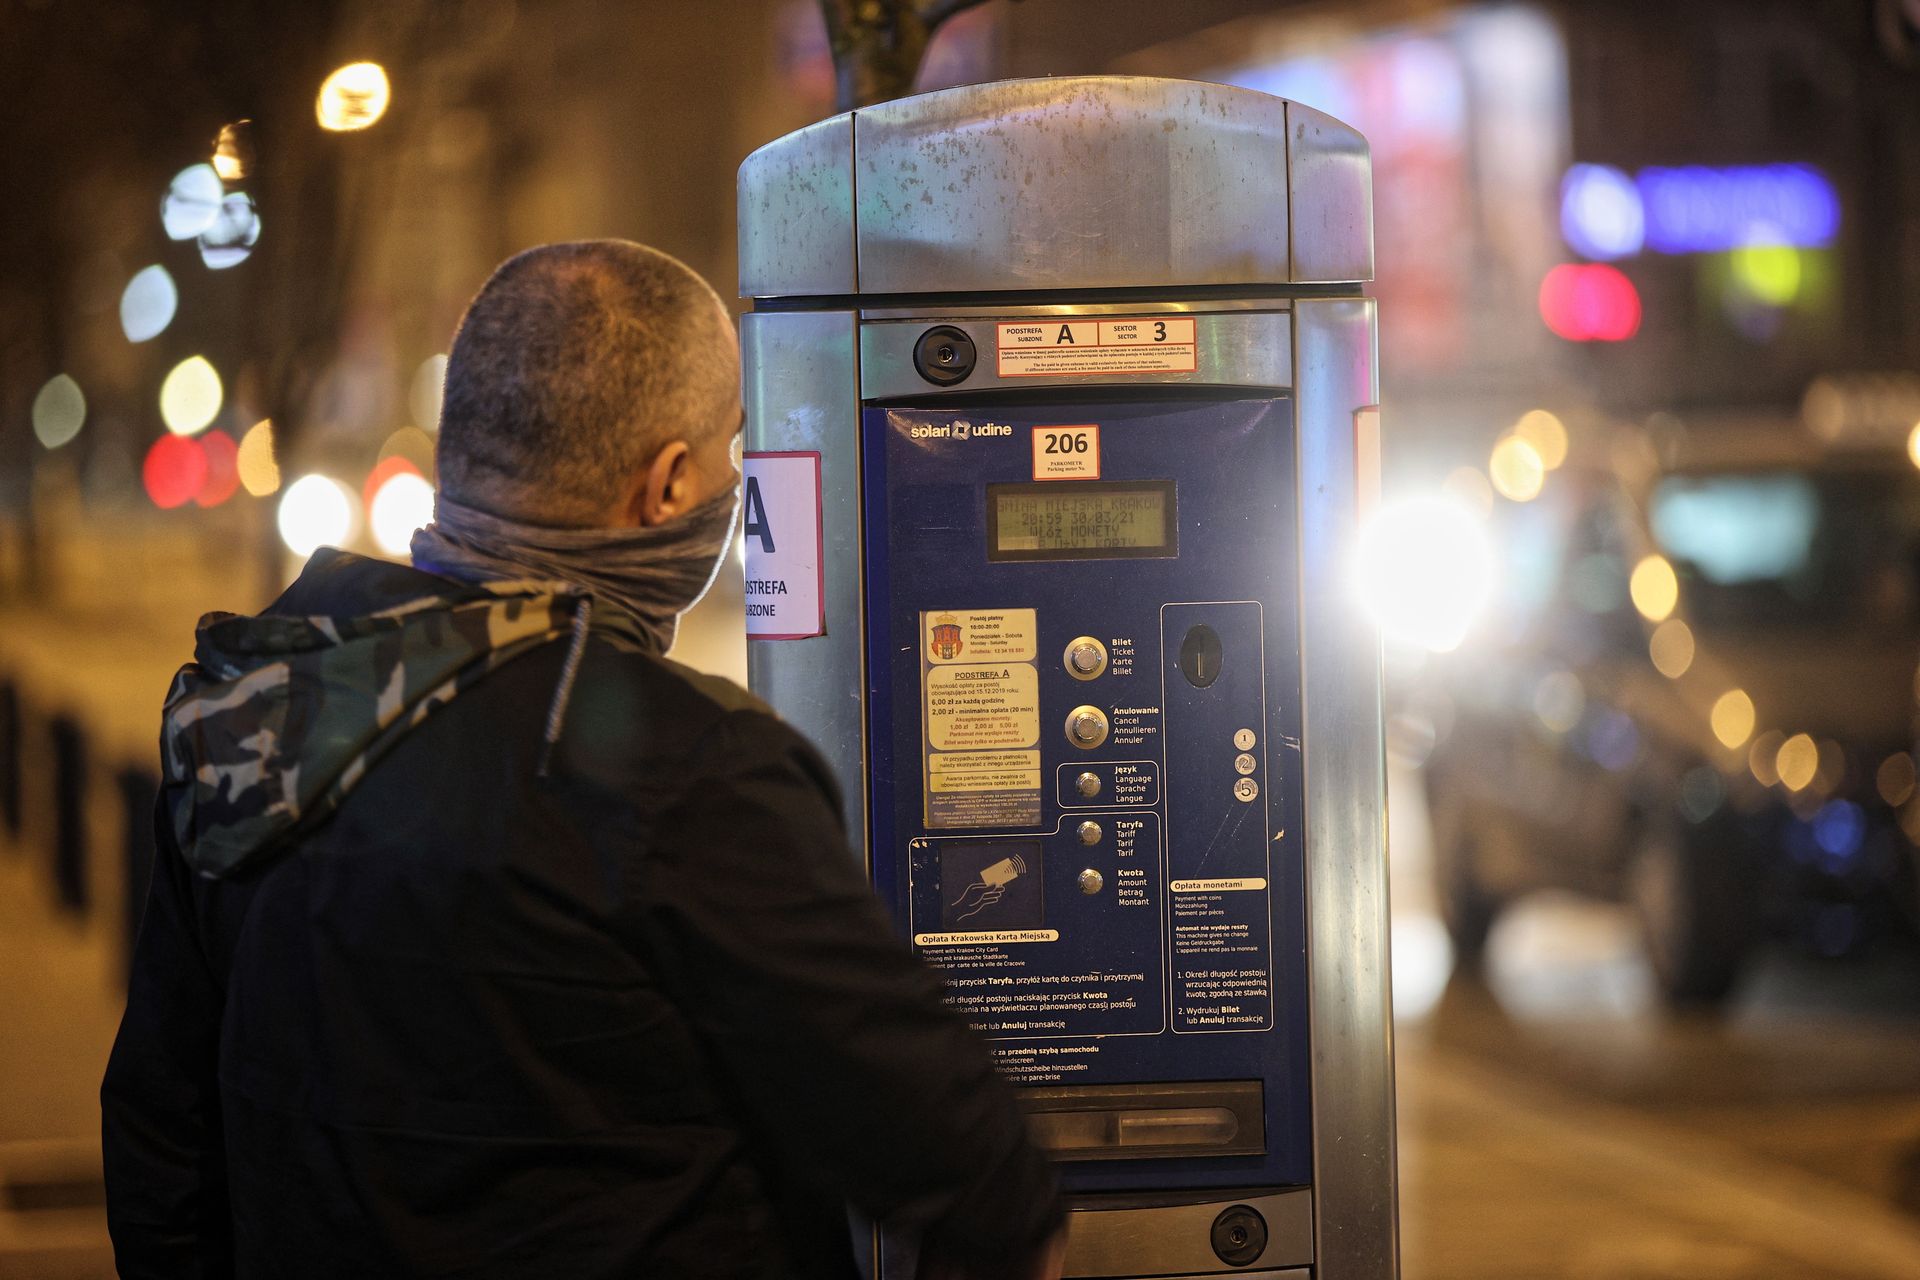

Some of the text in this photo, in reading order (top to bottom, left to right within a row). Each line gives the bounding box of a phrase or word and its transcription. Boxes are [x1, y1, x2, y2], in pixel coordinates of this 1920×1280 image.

[1057, 325, 1074, 344] A
[1154, 322, 1167, 342] 3
[911, 423, 1012, 438] solari udine
[1045, 433, 1088, 454] 206
[1045, 499, 1103, 512] MIEJSKA
[744, 476, 776, 553] A
[1022, 511, 1135, 526] 20:59 30/03/21
[1070, 524, 1120, 537] MONETY
[745, 580, 787, 595] DSTREFA
[745, 604, 776, 617] UBZONE
[1112, 638, 1132, 646] Bilet
[1112, 648, 1135, 656] Ticket
[1112, 658, 1132, 666] Karte
[955, 669, 1010, 679] PODSTREFA A
[981, 697, 1005, 705] godzinę
[932, 708, 946, 716] 2,00
[1114, 707, 1159, 715] Anulowanie
[1114, 717, 1139, 725] Cancel
[1114, 726, 1157, 734] Annullieren
[1114, 736, 1144, 744] Annuler
[1242, 734, 1247, 742] 1
[1239, 758, 1250, 769] 2
[1114, 765, 1137, 774] Język
[1115, 775, 1152, 784] Language
[1115, 784, 1146, 794] Sprache
[1241, 783, 1252, 797] 5
[1116, 795, 1144, 803] Langue
[1116, 820, 1143, 829] Taryfa
[1116, 830, 1136, 838] Tariff
[1117, 849, 1133, 857] Tarif
[1117, 869, 1144, 877] Kwota
[1175, 882, 1201, 890] Opłata
[1118, 888, 1143, 897] Betrag
[1119, 898, 1149, 906] Montant
[922, 932, 1050, 944] Opłata Krakowską Kartą Miejską
[1185, 971, 1208, 979] Określ
[1210, 970, 1238, 979] długość
[1240, 969, 1266, 978] postoju
[959, 979, 987, 987] przycisk
[1016, 977, 1041, 985] przyłóż
[1041, 976, 1059, 984] kartę
[1071, 974, 1099, 983] czytnika
[1104, 972, 1144, 983] przytrzymaj
[1186, 979, 1267, 989] wrzucając odpowiednią
[957, 991, 1108, 1005] długość postoju naciskając przycisk Kwota
[1209, 990, 1233, 999] zgodną
[1243, 989, 1267, 997] stawką
[991, 1003, 1038, 1013] wyświetlaczu
[1039, 1001, 1087, 1012] planowanego
[1110, 1001, 1136, 1009] postoju
[1186, 1007, 1220, 1016] Wydrukuj
[1199, 1016, 1225, 1025] Anuluj
[1226, 1015, 1264, 1024] transakcję
[1001, 1021, 1027, 1030] Anuluj
[1029, 1020, 1066, 1029] transakcję
[1007, 1048, 1038, 1056] przednią
[1039, 1047, 1059, 1055] szybą
[1028, 1073, 1061, 1082] pare-brise
